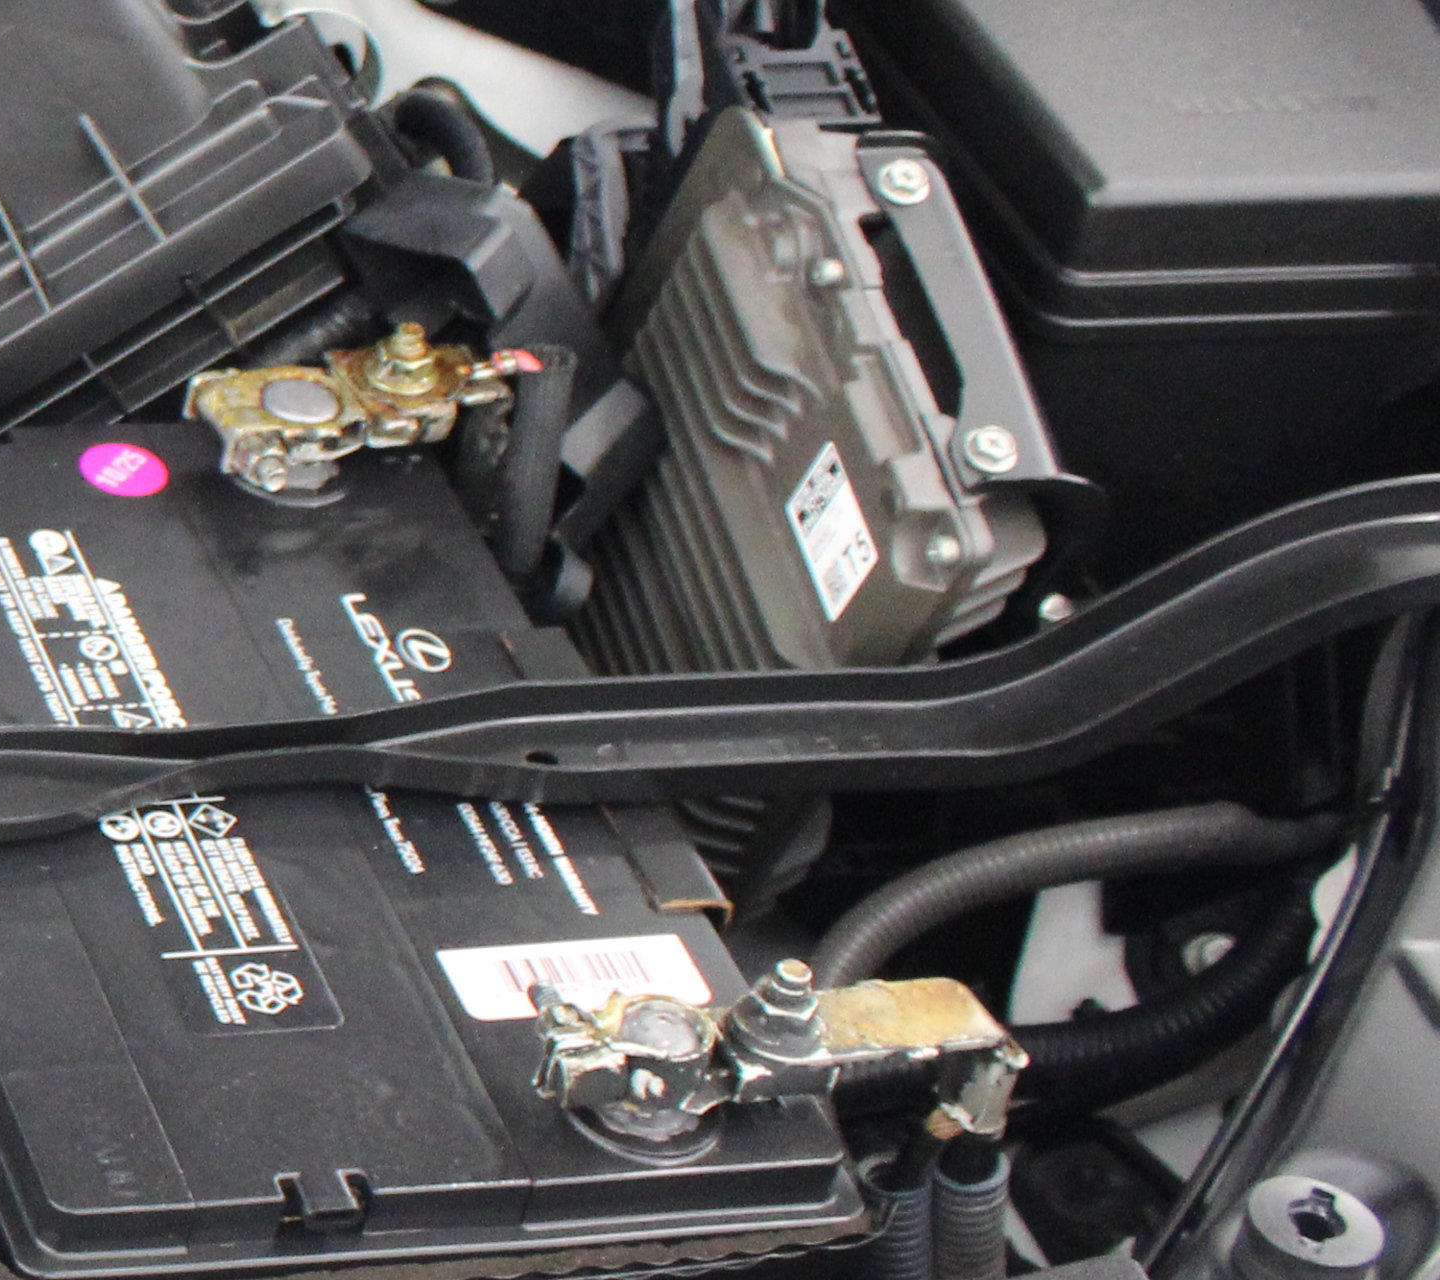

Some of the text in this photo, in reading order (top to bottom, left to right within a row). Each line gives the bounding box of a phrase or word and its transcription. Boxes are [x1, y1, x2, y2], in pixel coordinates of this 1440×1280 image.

[19, 636, 42, 663] VENT
[31, 663, 55, 691] CAPS
[45, 692, 68, 720] TIGHT
[129, 844, 156, 874] READ
[393, 841, 426, 872] 75024
[550, 856, 598, 914] WARRANTY
[198, 974, 232, 1022] RECYCLED
